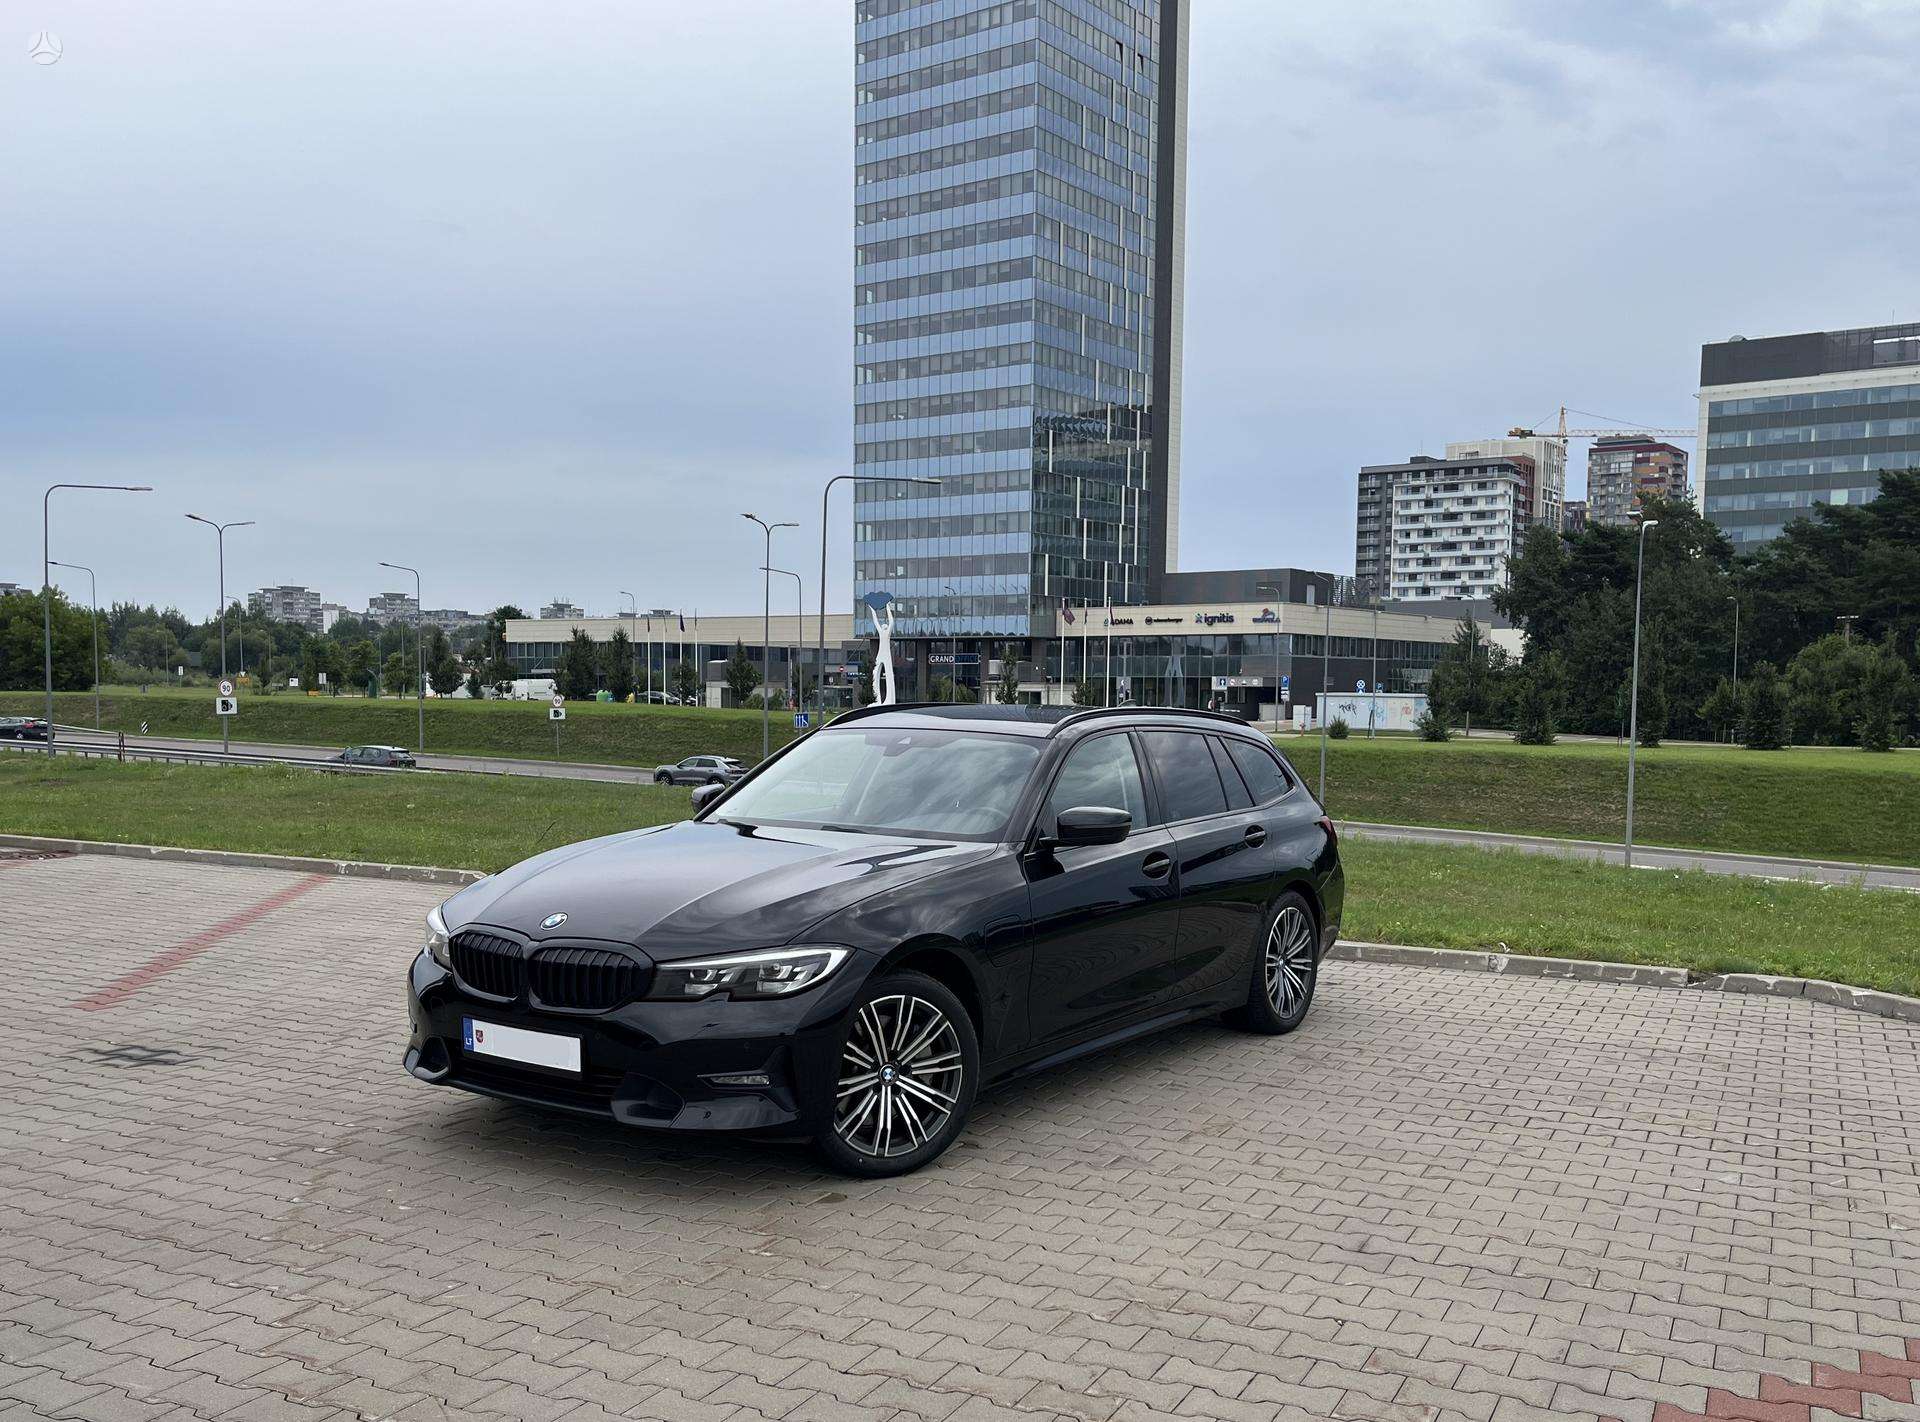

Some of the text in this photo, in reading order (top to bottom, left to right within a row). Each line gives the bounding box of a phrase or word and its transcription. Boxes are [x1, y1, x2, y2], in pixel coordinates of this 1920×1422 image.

[1204, 613, 1235, 626] ignitis
[930, 655, 954, 663] GRAND
[222, 685, 230, 693] 90
[465, 1037, 473, 1045] LT
